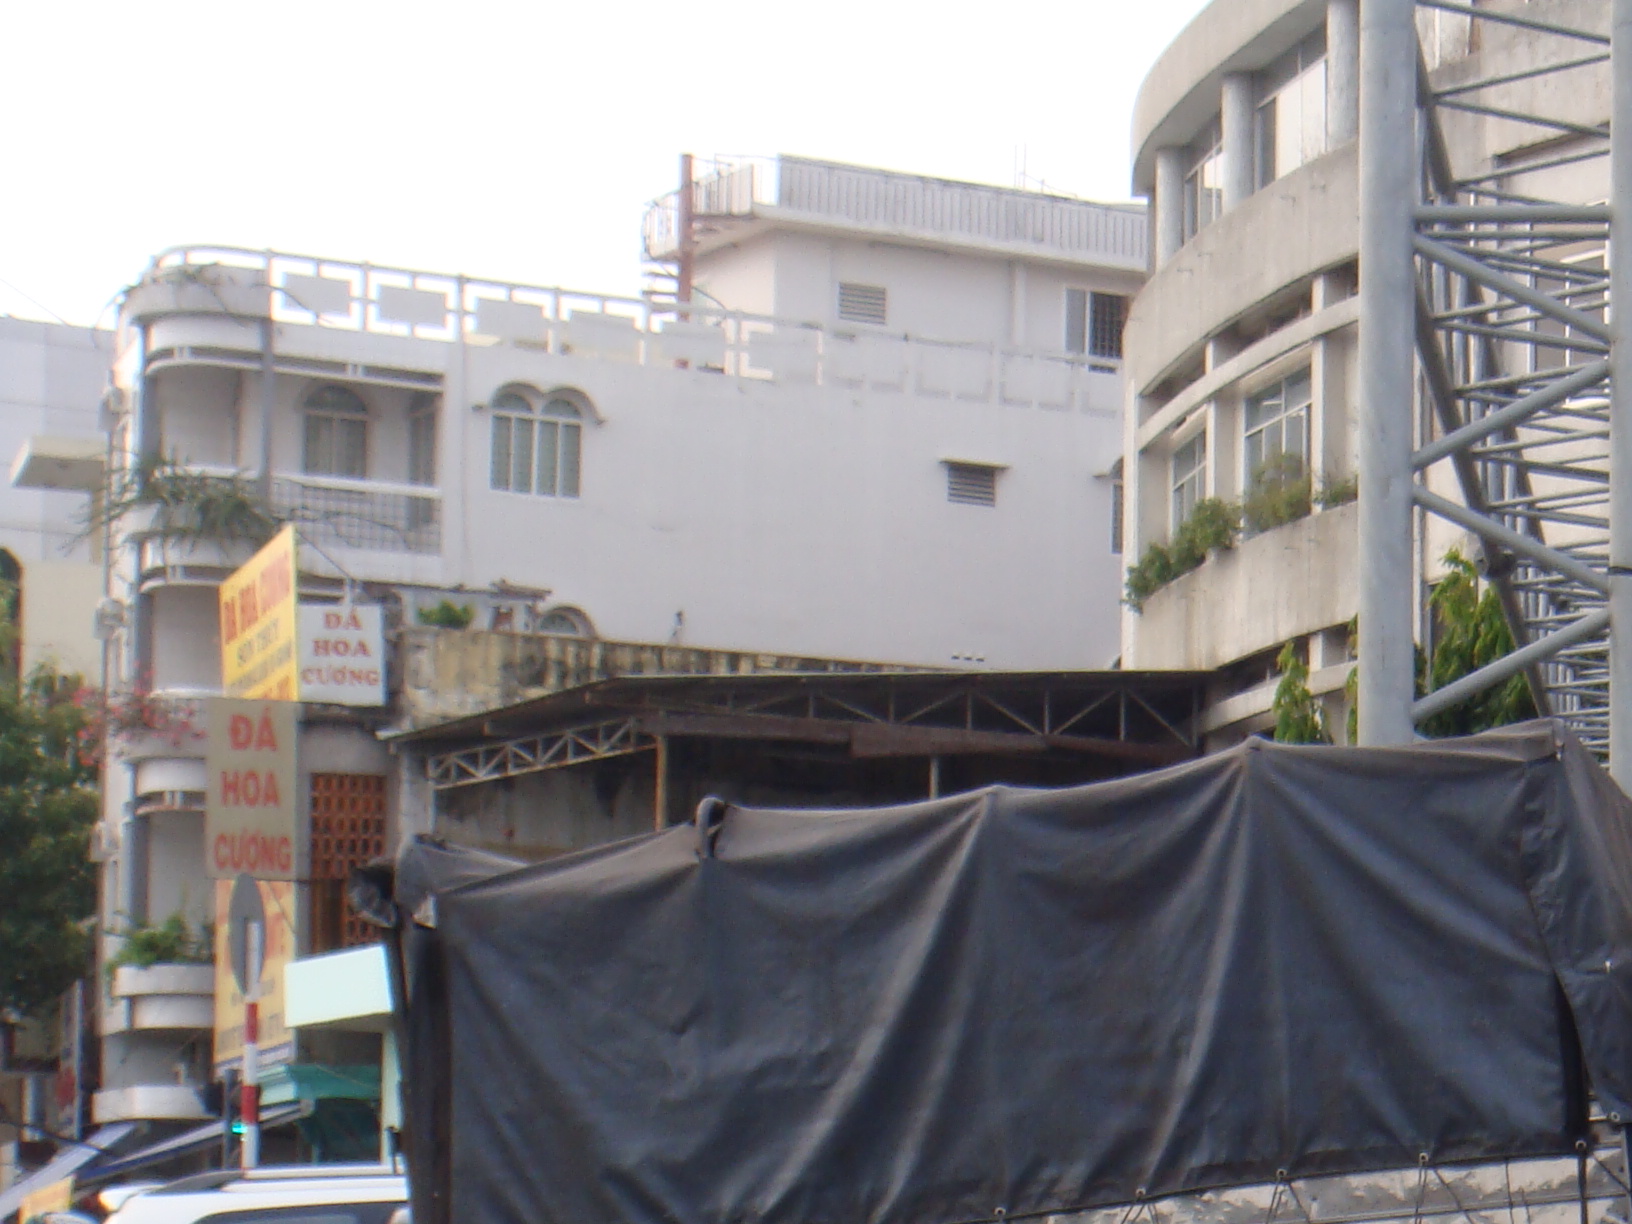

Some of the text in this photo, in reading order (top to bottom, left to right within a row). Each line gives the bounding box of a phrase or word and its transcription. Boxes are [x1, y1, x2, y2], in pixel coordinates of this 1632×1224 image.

[312, 638, 372, 657] HOA
[228, 706, 278, 751] ĐÁ
[220, 770, 281, 808] HOA
